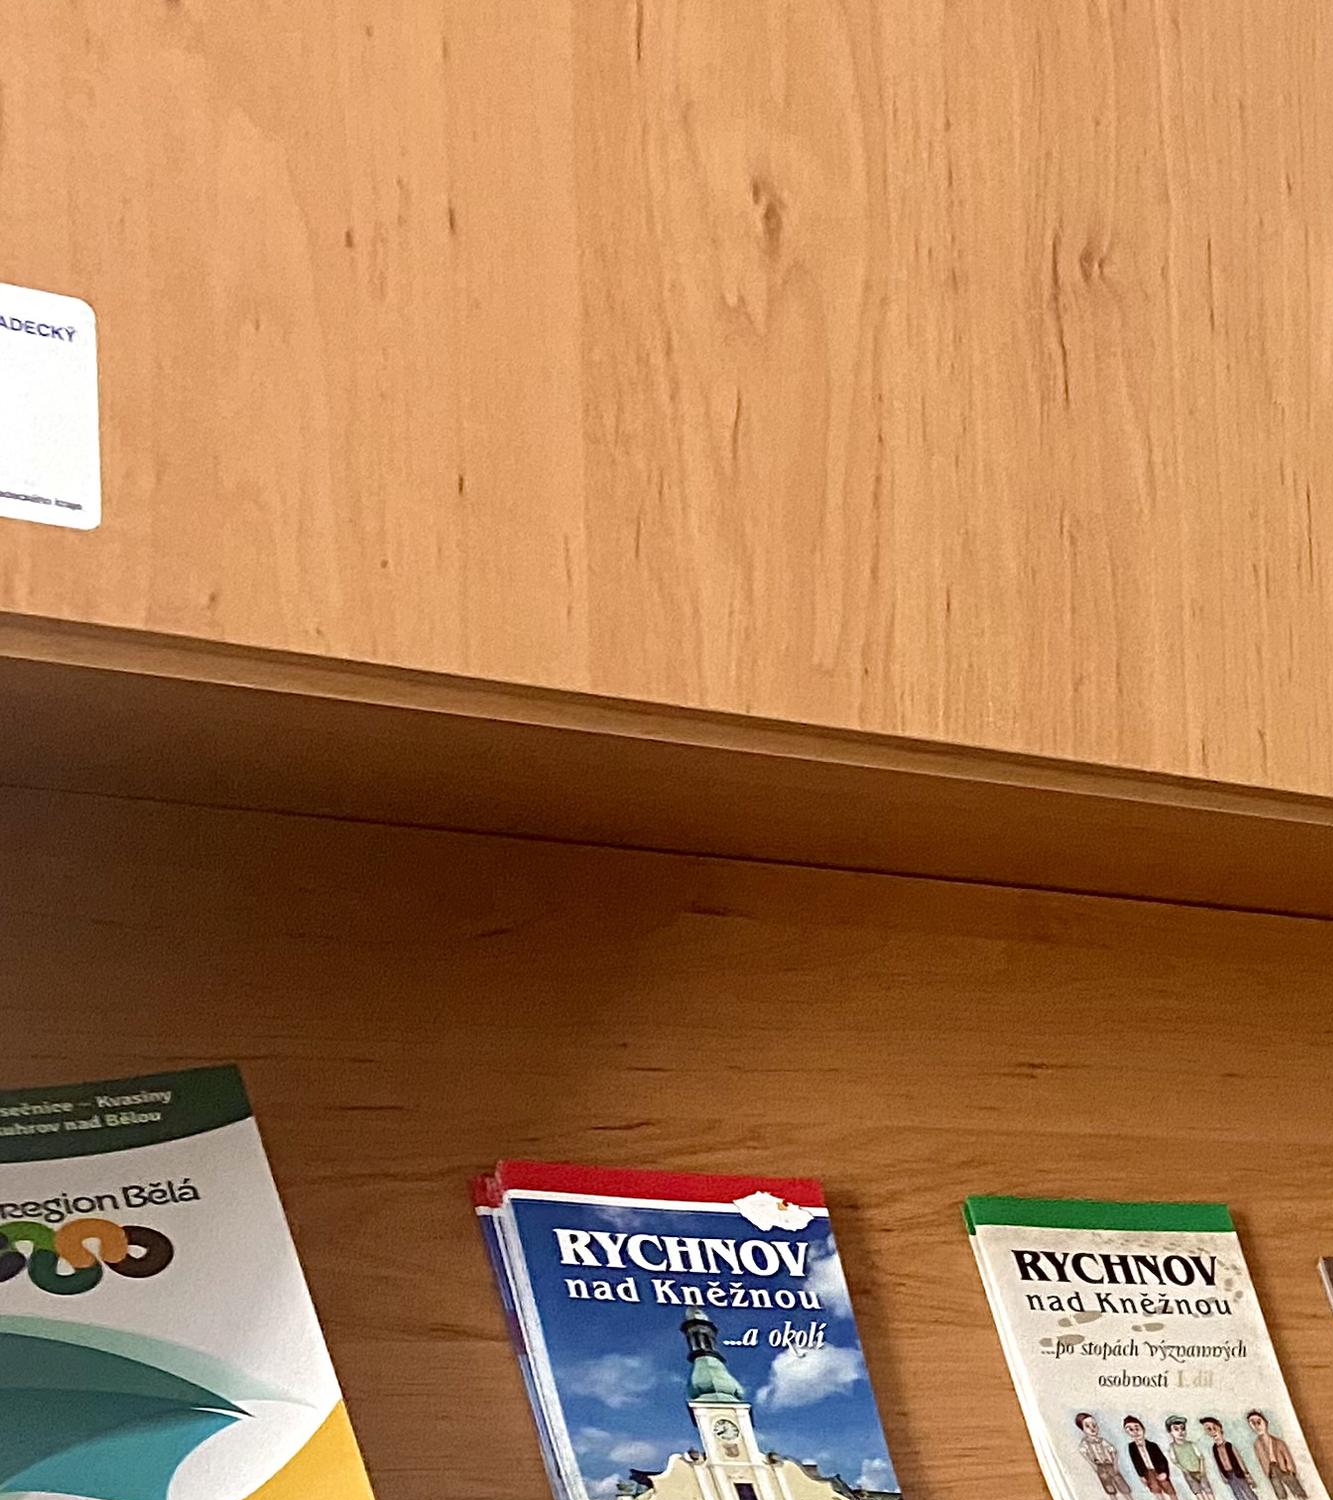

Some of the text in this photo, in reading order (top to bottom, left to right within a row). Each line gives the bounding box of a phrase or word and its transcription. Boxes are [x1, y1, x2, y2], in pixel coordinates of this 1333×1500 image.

[95, 1090, 173, 1108] Kvasiny
[65, 1115, 101, 1131] nad
[104, 1111, 162, 1127] Bělou
[122, 1178, 201, 1208] Bělá
[553, 1228, 808, 1277] RYCHNOV
[1011, 1250, 1217, 1286] RYCHNOV
[566, 1277, 822, 1310] nad Kněžnou
[1025, 1291, 1233, 1316] nad Kněžnou
[768, 1322, 827, 1357] okolí
[1081, 1339, 1139, 1360] stopách
[1144, 1339, 1247, 1363] významných
